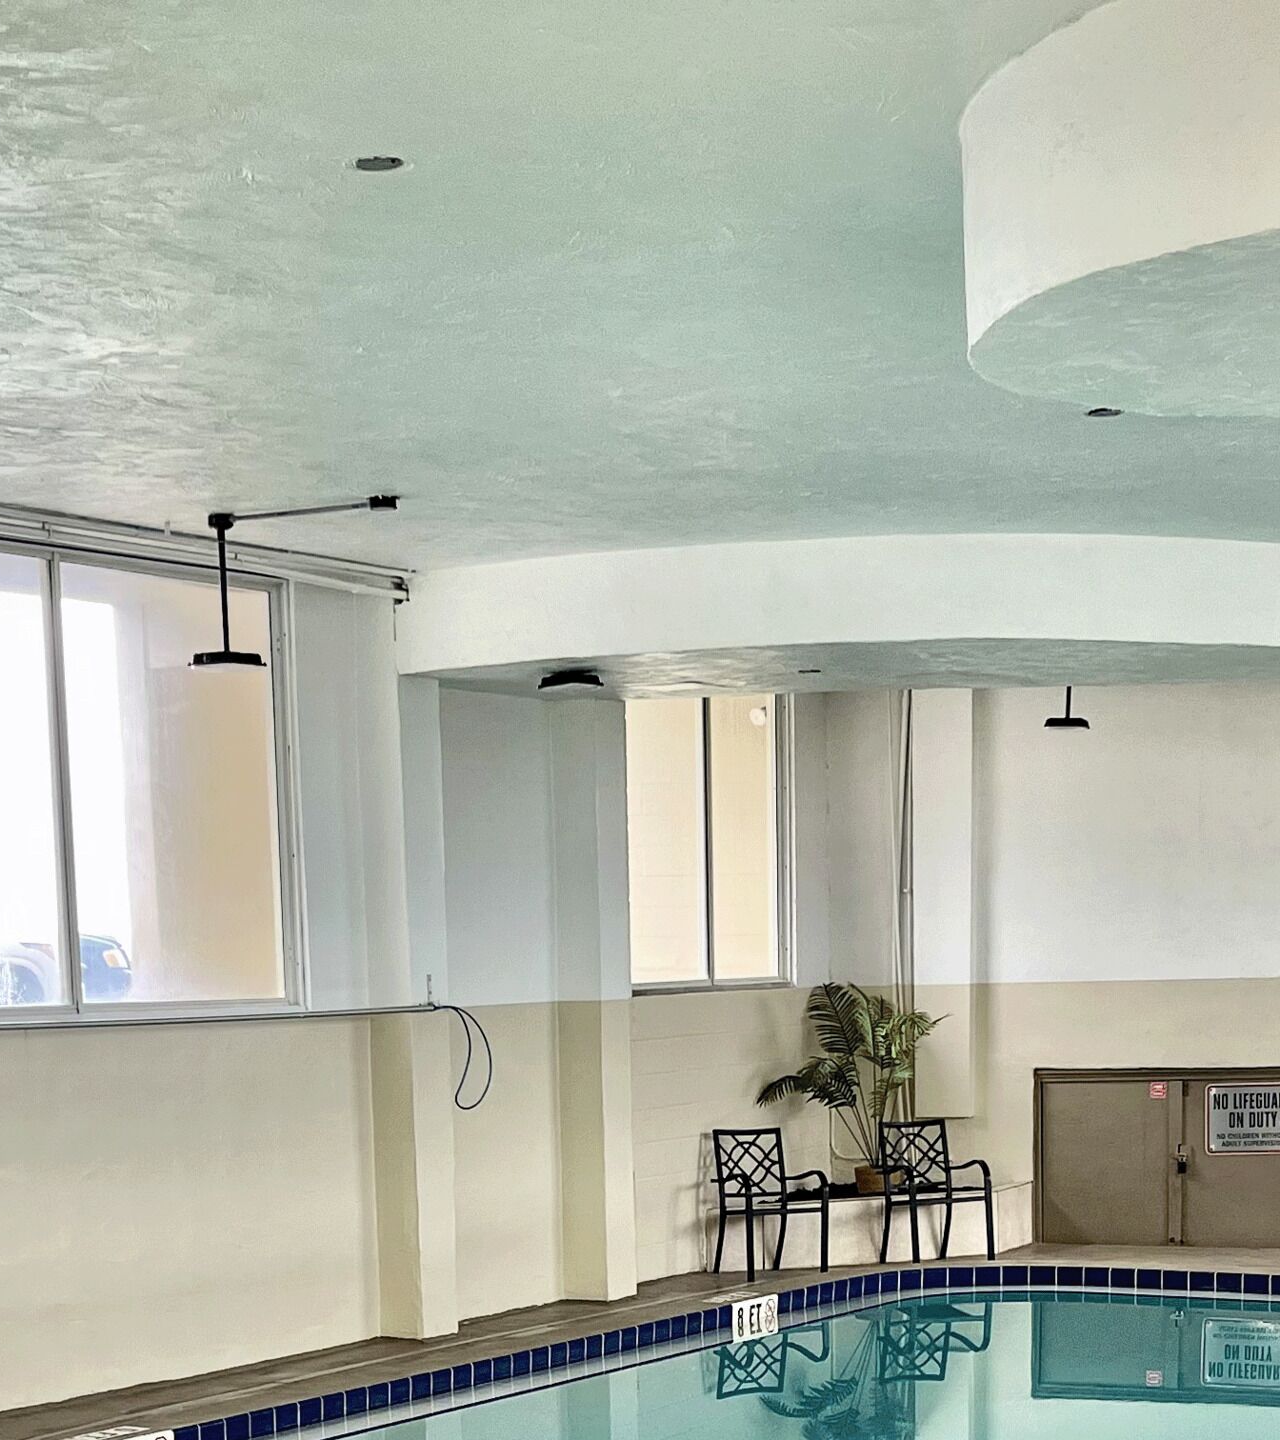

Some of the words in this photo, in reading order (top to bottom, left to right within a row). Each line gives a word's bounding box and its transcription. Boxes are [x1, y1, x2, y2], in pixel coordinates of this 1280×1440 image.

[1213, 1093, 1228, 1110] NO
[1229, 1112, 1244, 1128] ON
[1249, 1111, 1277, 1128] DUTY
